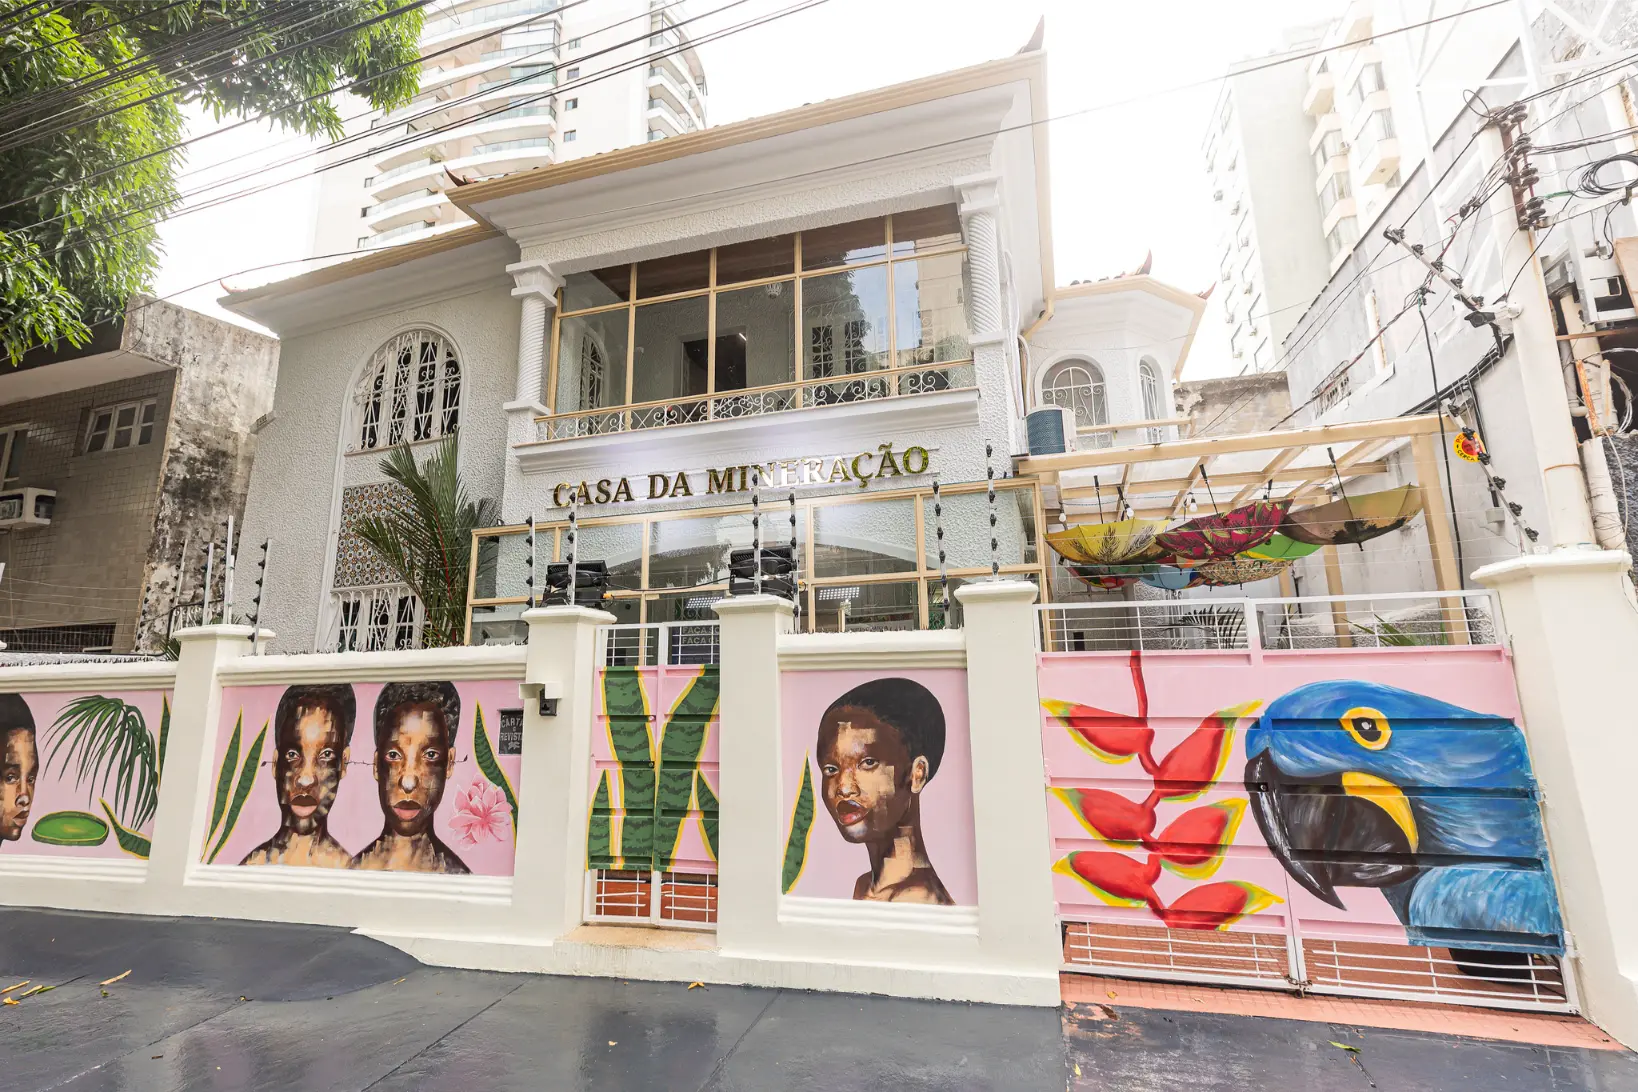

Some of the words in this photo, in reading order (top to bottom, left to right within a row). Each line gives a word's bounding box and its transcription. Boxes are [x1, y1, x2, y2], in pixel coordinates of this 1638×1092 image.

[553, 477, 635, 507] CASA
[647, 471, 693, 499] DA
[705, 442, 929, 495] MINERAÇÃO
